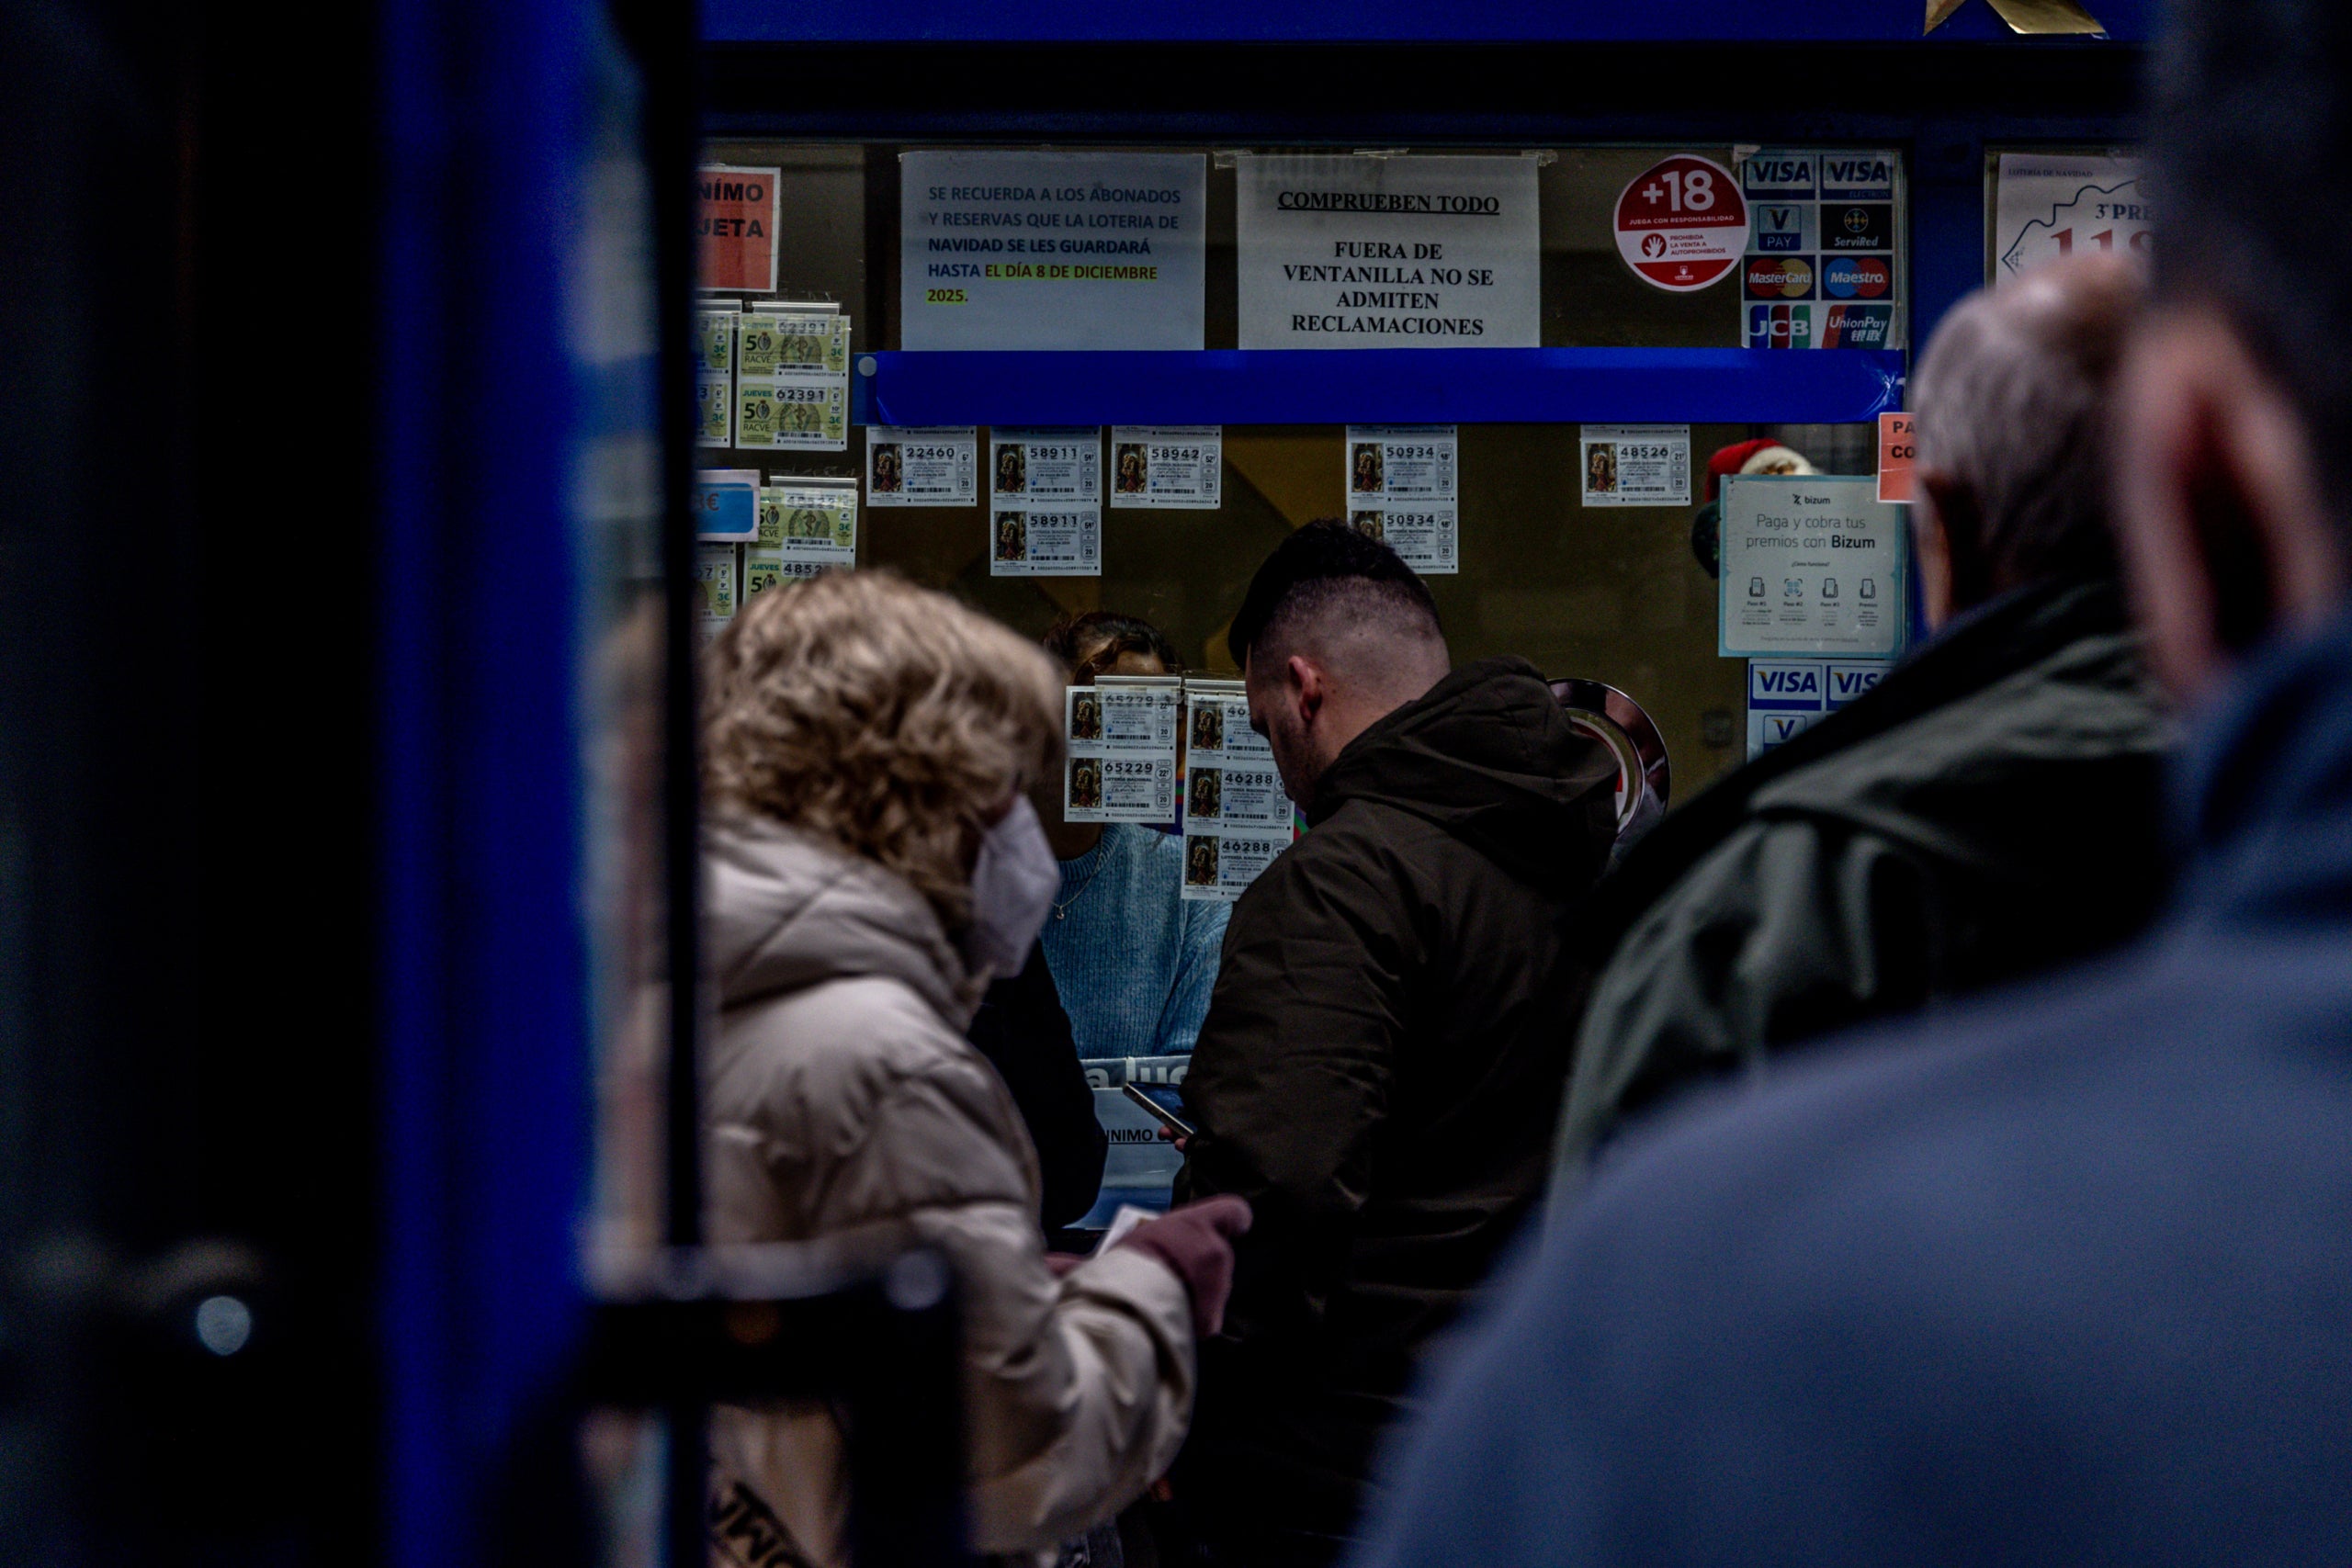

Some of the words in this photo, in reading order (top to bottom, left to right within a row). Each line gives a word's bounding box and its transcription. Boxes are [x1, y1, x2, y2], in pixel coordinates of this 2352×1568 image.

[1751, 161, 1811, 182] VISA
[1828, 161, 1888, 182] VISA
[929, 186, 946, 200] SE
[952, 187, 1035, 201] RECUERDA
[1041, 188, 1051, 201] A
[1057, 188, 1085, 202] LOS
[1090, 188, 1181, 203] ABONADOS
[1643, 169, 1715, 212] +18
[1849, 190, 1889, 198] ELECTRON
[1278, 191, 1431, 212] COMPRUEBEN
[1437, 195, 1499, 213] TODO
[929, 212, 938, 226] Y
[943, 212, 1022, 227] RESERVAS
[1027, 213, 1060, 229] QUE
[1066, 214, 1082, 228] LA
[1089, 214, 1152, 229] LOTERIA
[1159, 216, 1179, 229] DE
[1670, 215, 1735, 223] RESPONSABILIDAD
[1769, 209, 1790, 230] V
[929, 239, 1002, 253] NAVIDAD
[1007, 239, 1025, 253] SE
[1030, 240, 1056, 253] LES
[1060, 237, 1150, 254] GUARDARÁ
[1767, 236, 1792, 248] PAY
[1834, 236, 1879, 247] ServiRed
[1335, 242, 1407, 259] FUERA
[1414, 243, 1442, 260] DE
[929, 264, 979, 277] HASTA
[985, 265, 1001, 277] EL
[1006, 262, 1032, 278] DÍA
[1036, 265, 1046, 278] 8
[1050, 265, 1069, 278] DE
[1074, 266, 1158, 279] DICIEMBRE
[1283, 265, 1425, 285] VENTANILLA
[1431, 268, 1462, 285] NO
[1468, 269, 1493, 286] SE
[1749, 272, 1811, 284] MasterCard
[1830, 271, 1884, 284] Maestro
[927, 288, 968, 302] 2025.
[1337, 291, 1440, 310] ADMITEN
[1292, 315, 1484, 335] RECLAMACIONES
[1749, 320, 1809, 336] JCB
[1829, 316, 1888, 332] UnionPay
[776, 389, 825, 400] 62391
[907, 447, 955, 457] 22460
[1031, 447, 1077, 457] 58911
[1151, 448, 1199, 459] 58942
[1386, 446, 1434, 457] 50934
[1621, 446, 1668, 457] 48526
[1804, 496, 1830, 504] bizum
[1031, 515, 1077, 525] 58911
[1386, 514, 1435, 525] 50934
[1757, 513, 1789, 530] Paga
[1793, 517, 1802, 530] y
[1805, 515, 1841, 528] cobra
[1846, 516, 1866, 529] tus
[1747, 535, 1798, 549] premios
[1804, 537, 1826, 548] con
[1831, 535, 1875, 548] Bizum
[750, 563, 779, 571] JUEVES
[785, 563, 823, 574] 4852
[1757, 671, 1817, 693] VISA
[1773, 719, 1795, 739] V
[1104, 762, 1153, 773] 65229
[1225, 773, 1273, 784] 46288
[1222, 840, 1270, 852] 46288
